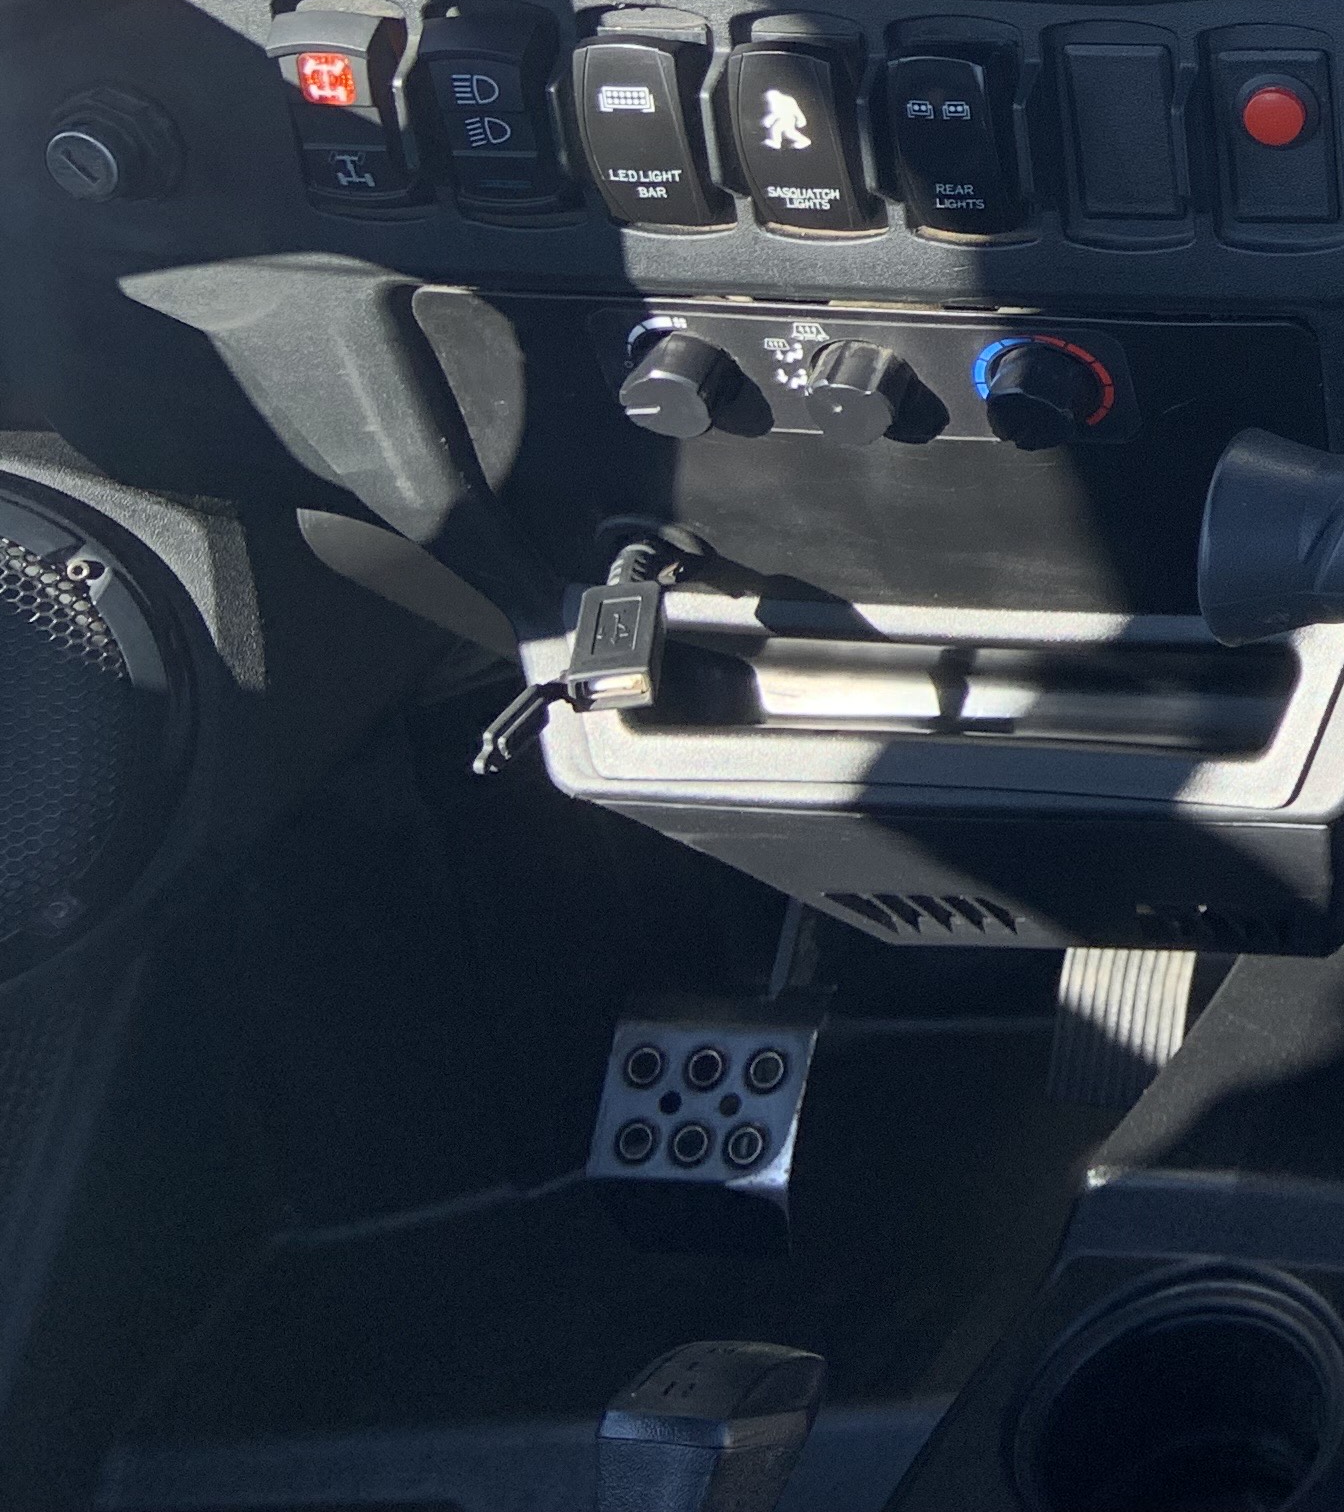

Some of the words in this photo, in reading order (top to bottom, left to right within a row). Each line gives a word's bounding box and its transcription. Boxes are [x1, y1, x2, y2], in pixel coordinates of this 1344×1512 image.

[608, 169, 638, 182] LED
[639, 170, 682, 183] LIGHT
[636, 186, 668, 198] BAR
[767, 186, 840, 200] SASQUATCH
[935, 183, 974, 195] REAR
[785, 197, 831, 210] LIGHTS
[936, 198, 985, 209] LIGHTS
